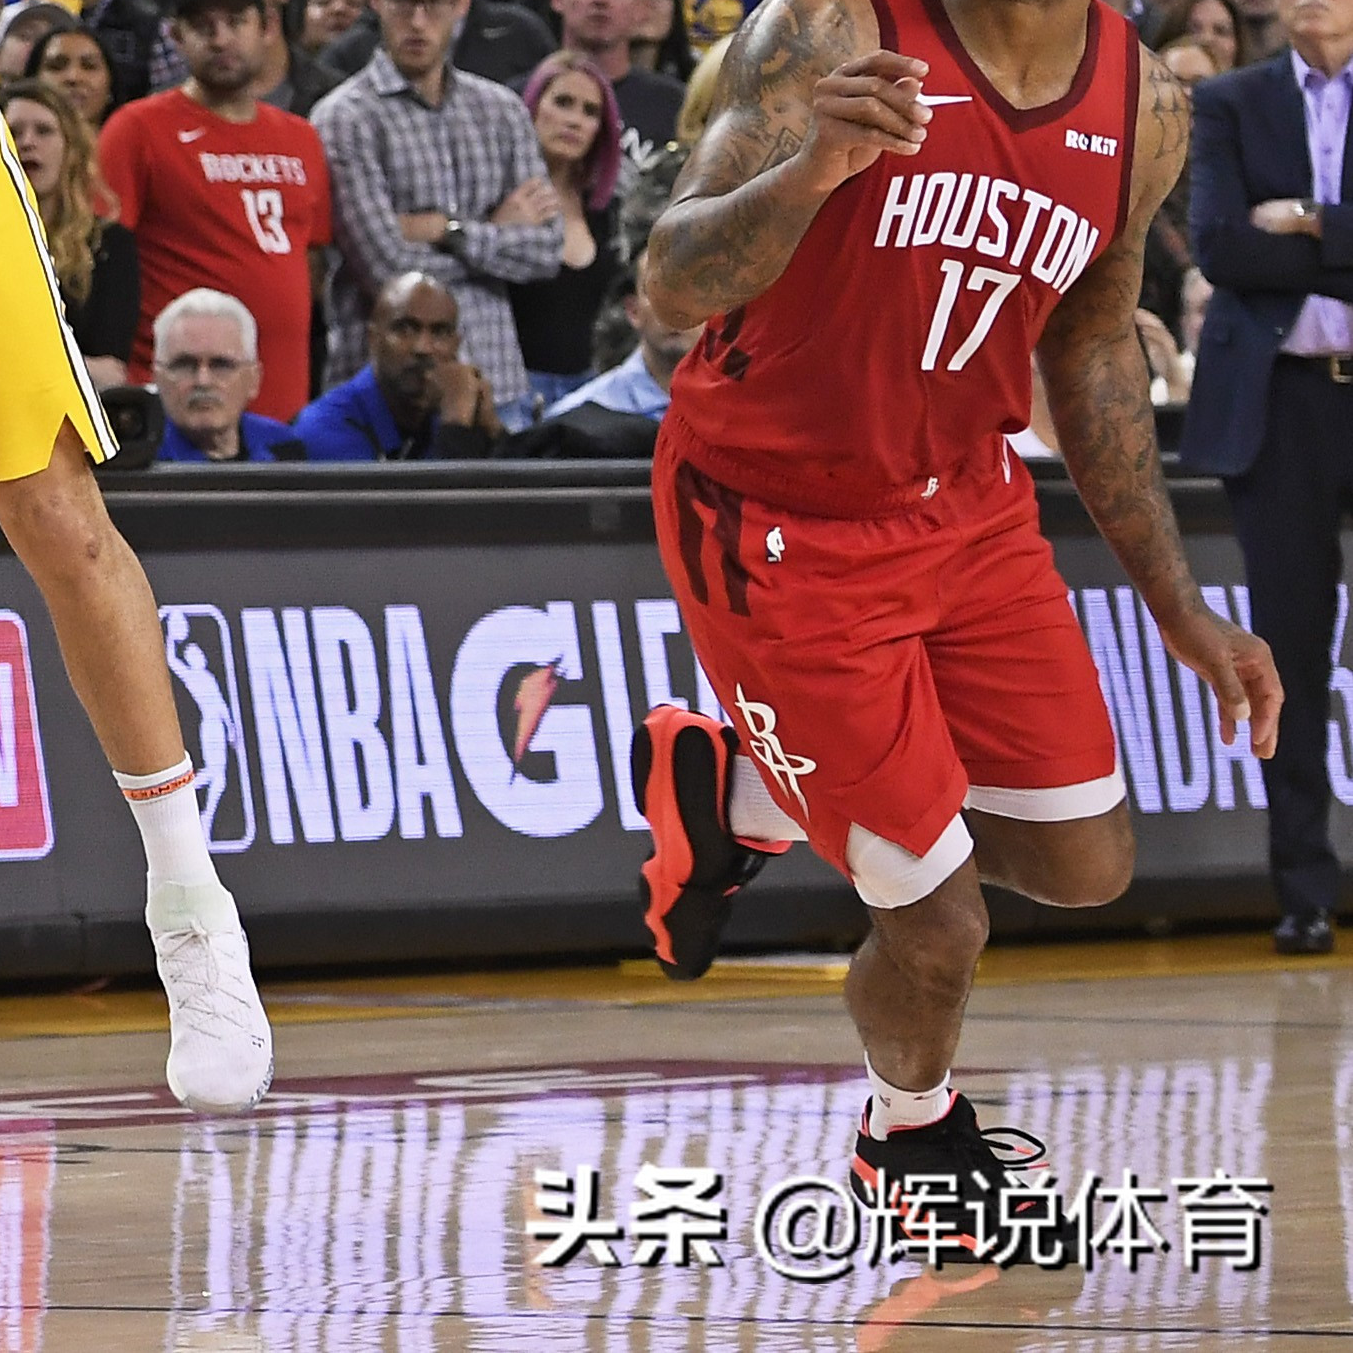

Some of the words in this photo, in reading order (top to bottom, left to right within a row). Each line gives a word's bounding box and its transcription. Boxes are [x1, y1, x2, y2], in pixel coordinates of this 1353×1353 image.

[199, 152, 307, 186] ROCKETS
[241, 189, 292, 255] 13
[873, 172, 1100, 296] HOUSTON
[920, 259, 1022, 371] 17
[240, 604, 464, 844] NBA
